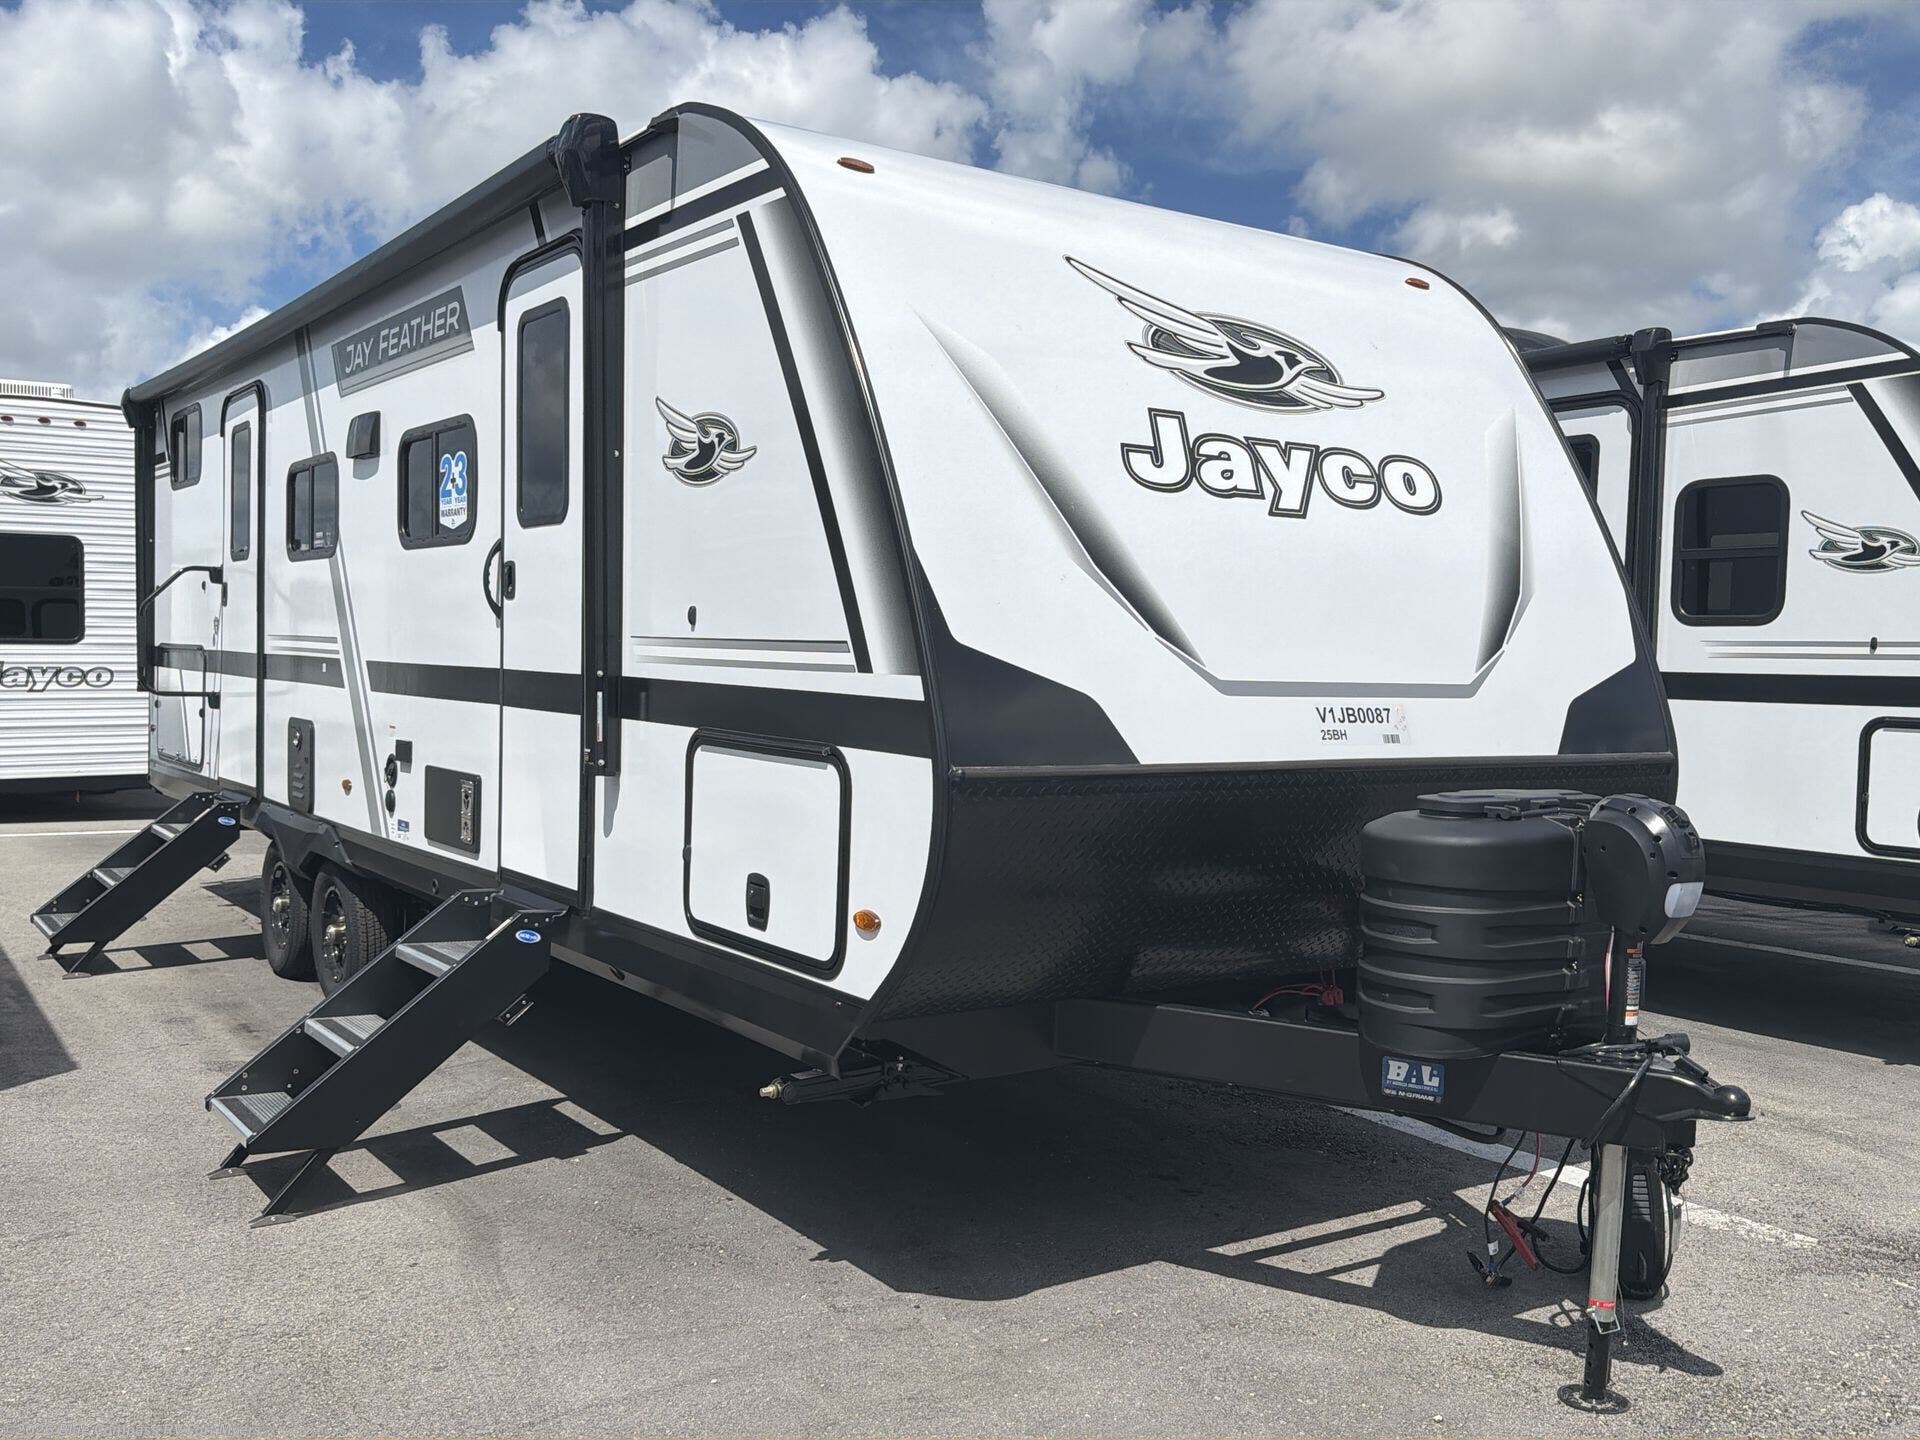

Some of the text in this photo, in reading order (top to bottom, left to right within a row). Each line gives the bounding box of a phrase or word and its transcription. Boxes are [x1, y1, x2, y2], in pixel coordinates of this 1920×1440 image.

[345, 301, 460, 374] JAY FEATHER
[1120, 407, 1443, 519] Jayco
[440, 506, 466, 518] WARRANTY
[0, 660, 115, 693] ayco
[1315, 706, 1391, 724] V1JB0087
[1320, 729, 1348, 741] 25BH
